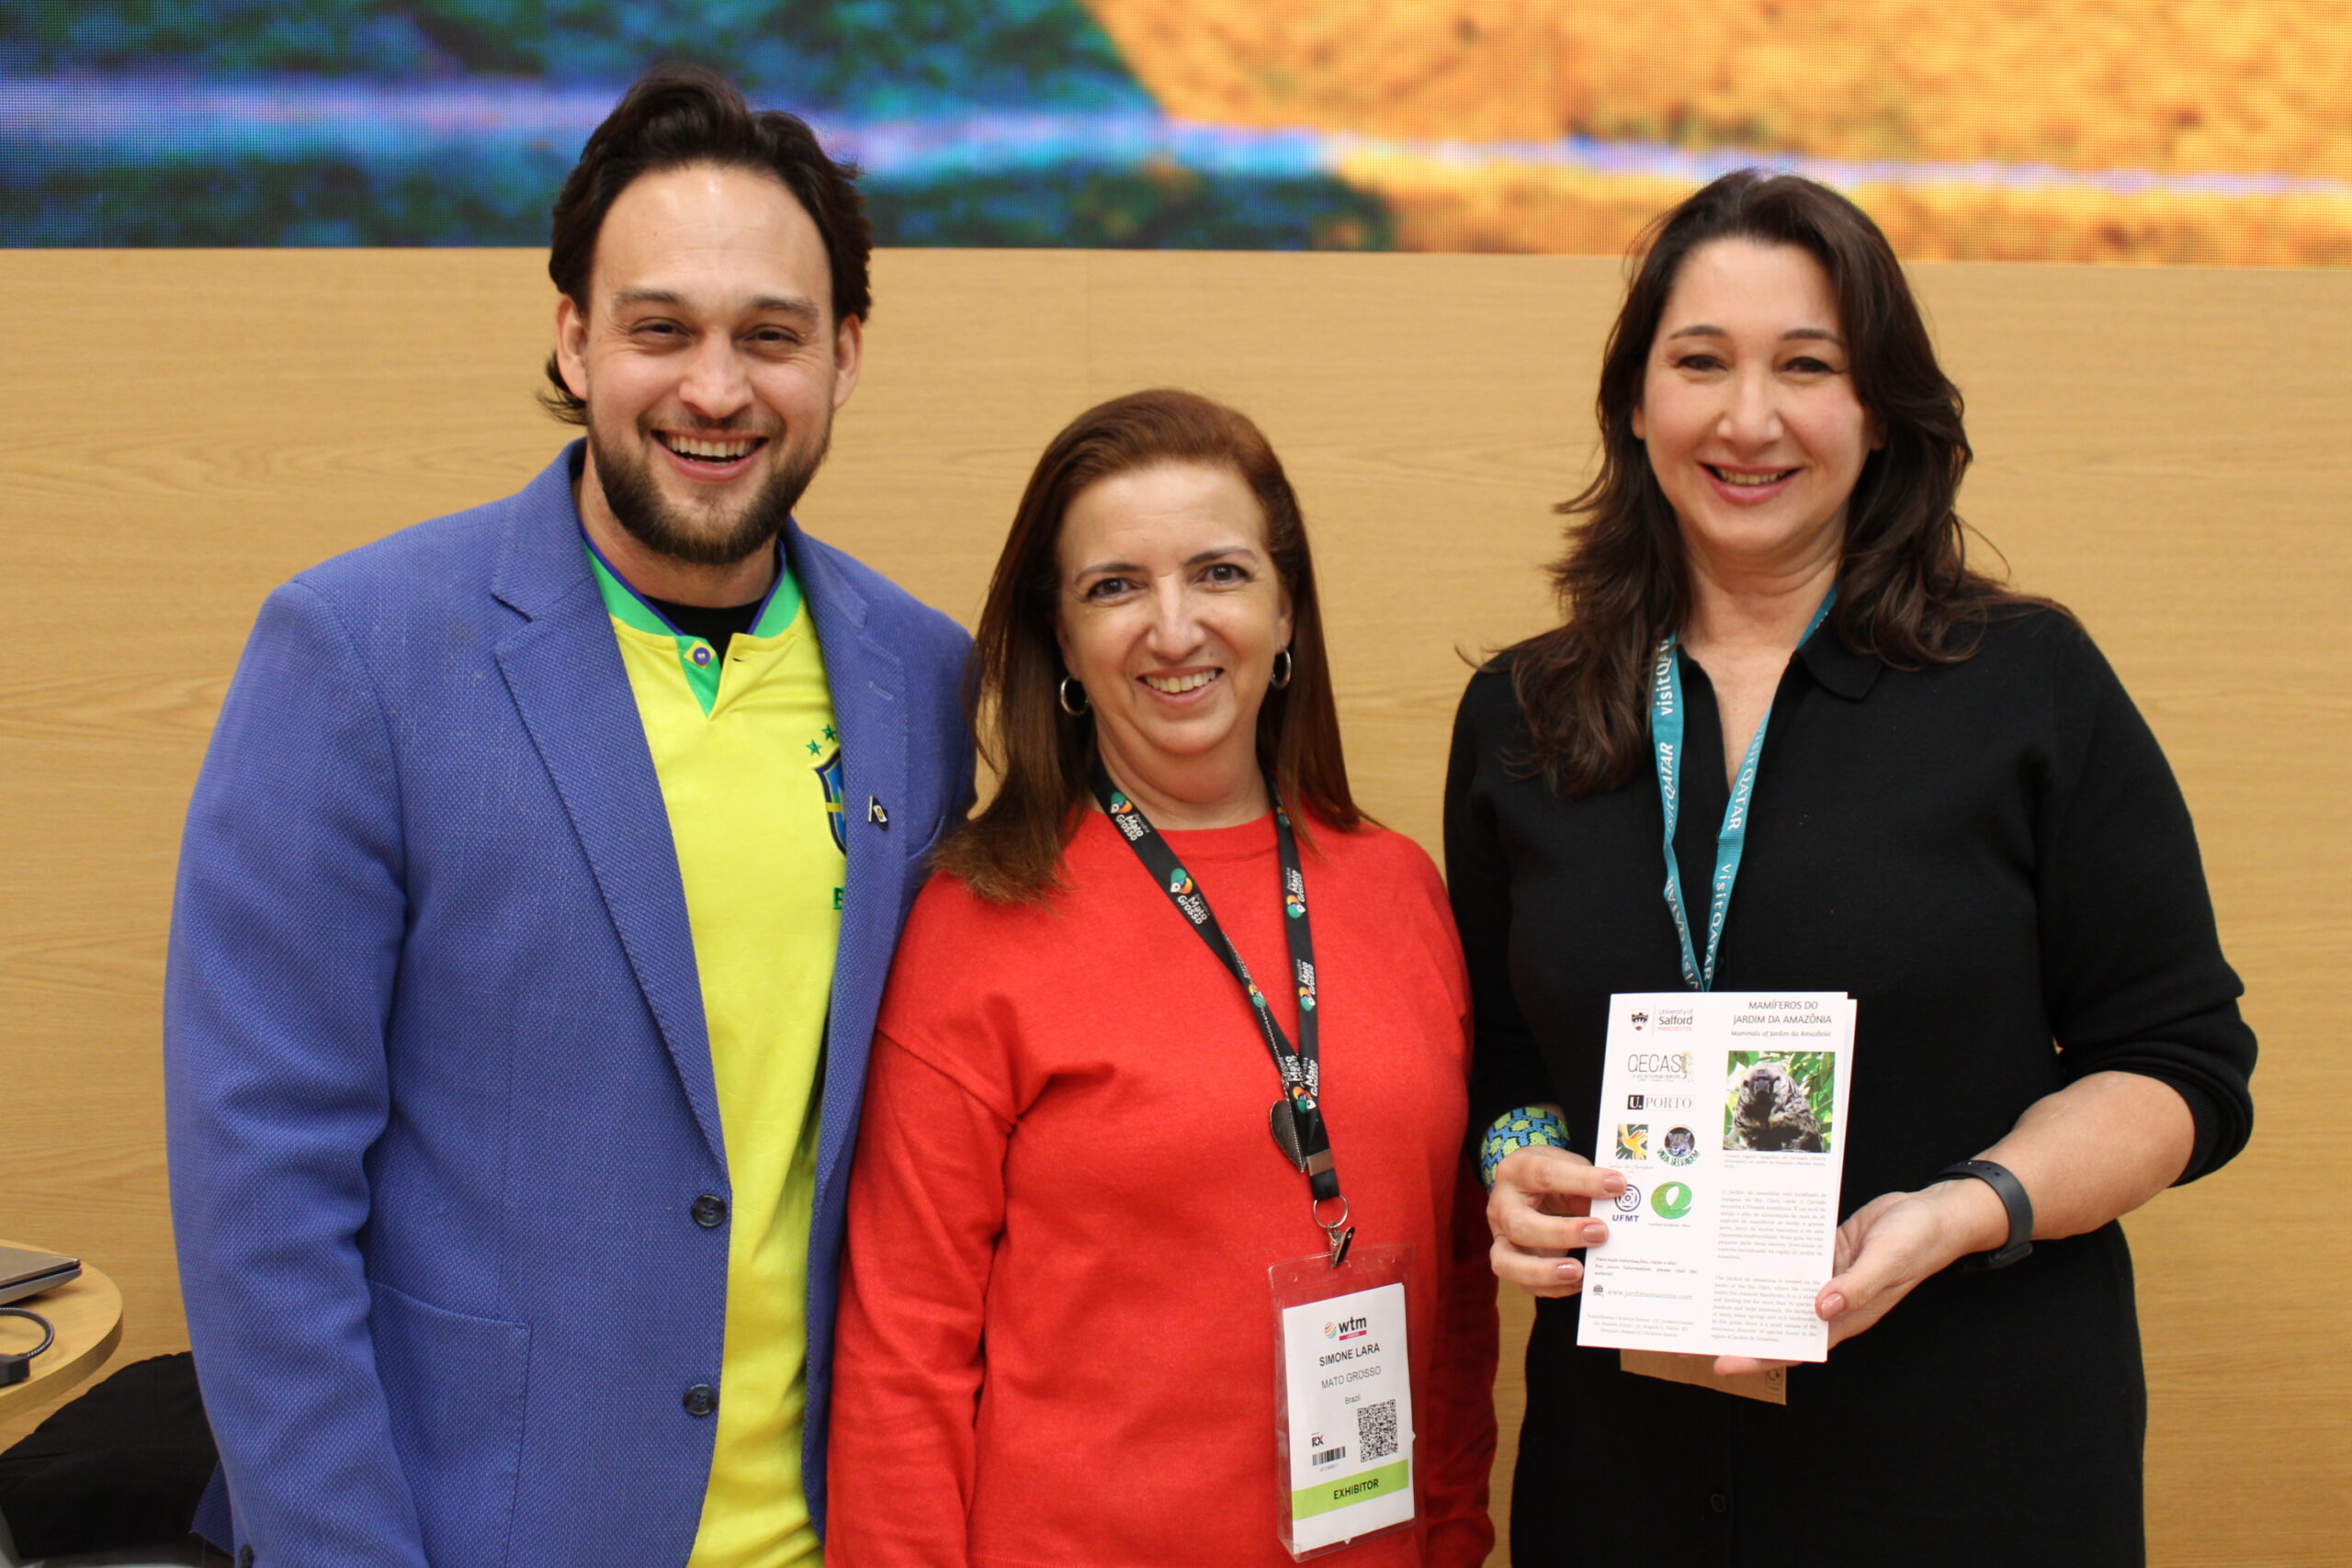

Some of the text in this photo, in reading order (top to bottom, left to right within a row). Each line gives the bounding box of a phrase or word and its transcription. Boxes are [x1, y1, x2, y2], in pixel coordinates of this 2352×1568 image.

[1115, 814, 1137, 840] Grosso
[1125, 815, 1144, 837] Mato
[1177, 895, 1203, 924] Grosso
[1187, 897, 1207, 920] Mato
[1704, 864, 1731, 981] visitQATAR
[1748, 999, 1818, 1010] MAMÍFEROS DO
[1658, 1016, 1693, 1025] Salford
[1733, 1013, 1832, 1025] JARDIM DA AMAZÔNIA
[1645, 1097, 1692, 1109] PORTO
[1611, 1214, 1640, 1223] UFMT
[1338, 1316, 1367, 1334] wtm
[1319, 1343, 1381, 1367] SIMONE LARA
[1321, 1366, 1382, 1389] MATO GROSSO
[1344, 1393, 1361, 1404] Brazil
[1311, 1435, 1324, 1447] RX
[1333, 1478, 1379, 1500] EXHIBITOR
